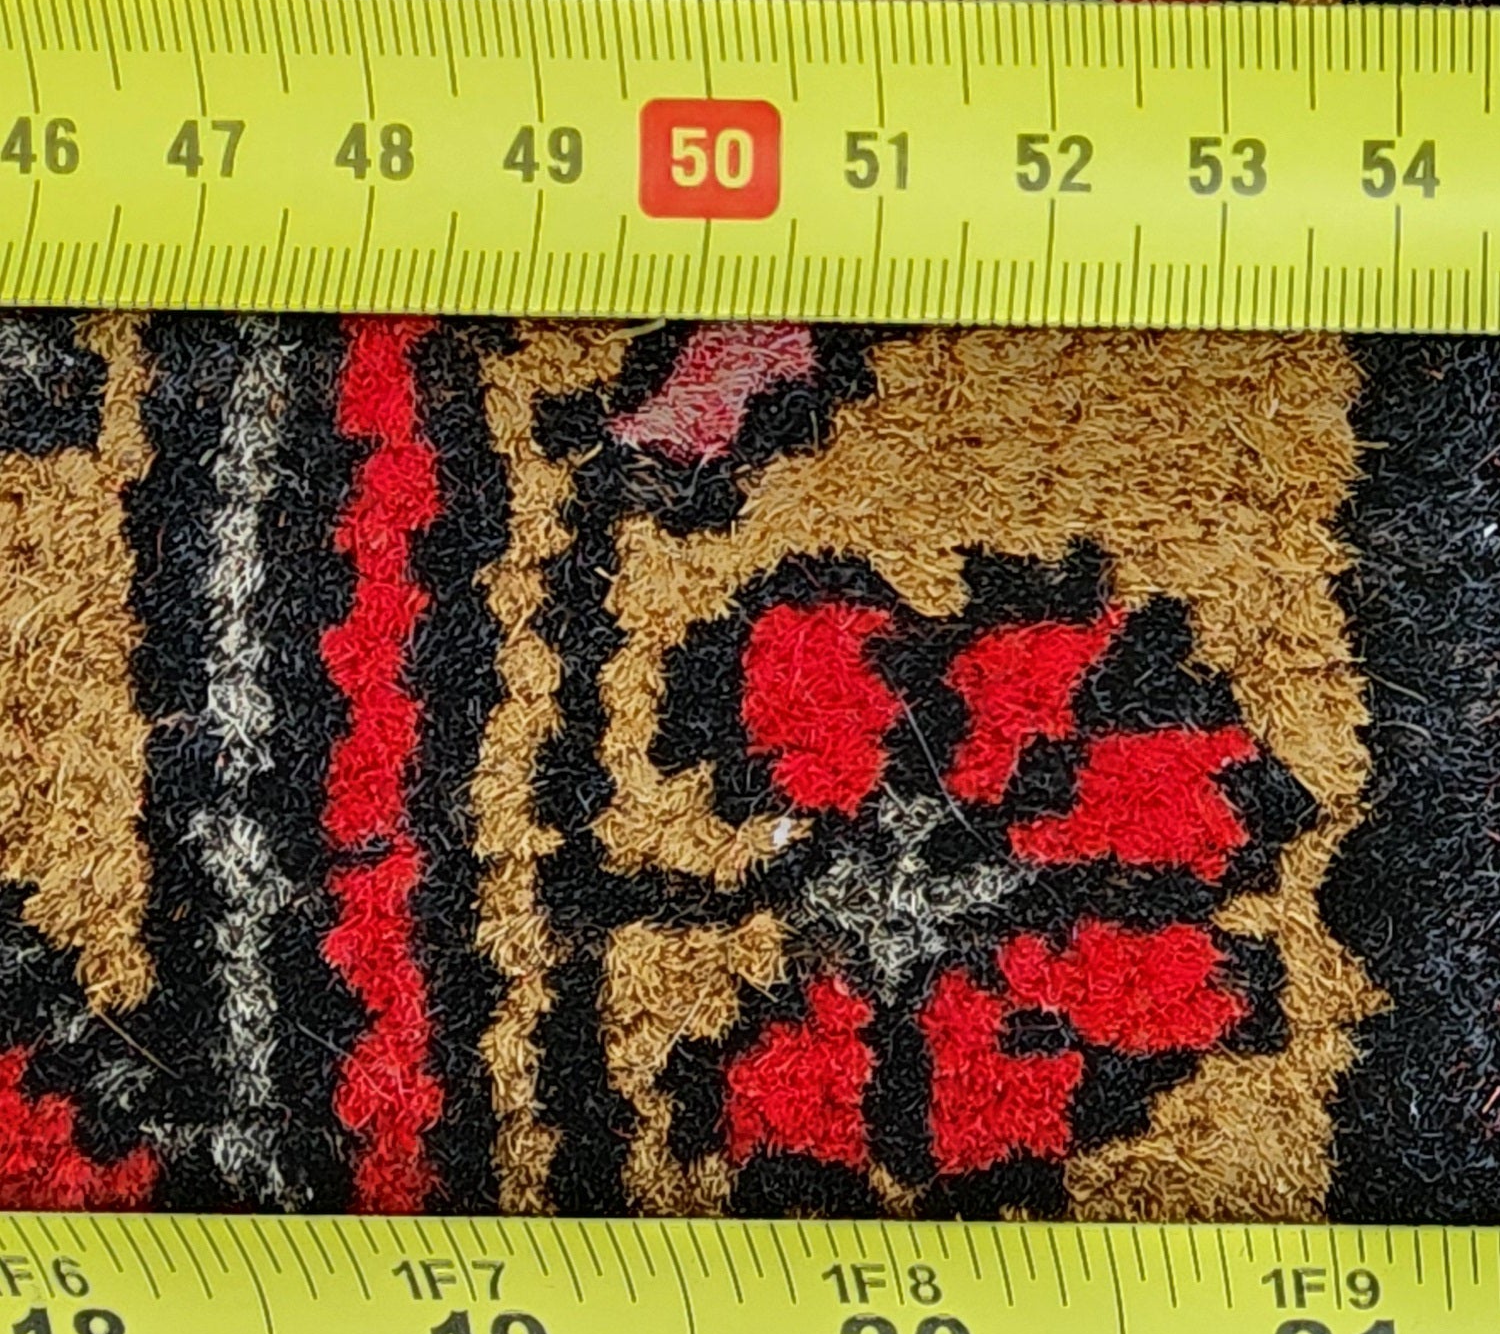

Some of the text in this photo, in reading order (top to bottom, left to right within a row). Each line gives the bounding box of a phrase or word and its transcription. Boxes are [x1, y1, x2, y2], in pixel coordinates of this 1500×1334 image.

[0, 116, 80, 175] 46
[167, 119, 246, 178] 47
[335, 122, 415, 181] 48
[503, 125, 583, 184] 49
[670, 127, 754, 187] 50
[845, 131, 909, 190] 51
[1016, 133, 1093, 193] 52
[1189, 136, 1267, 196] 53
[1362, 139, 1441, 199] 54
